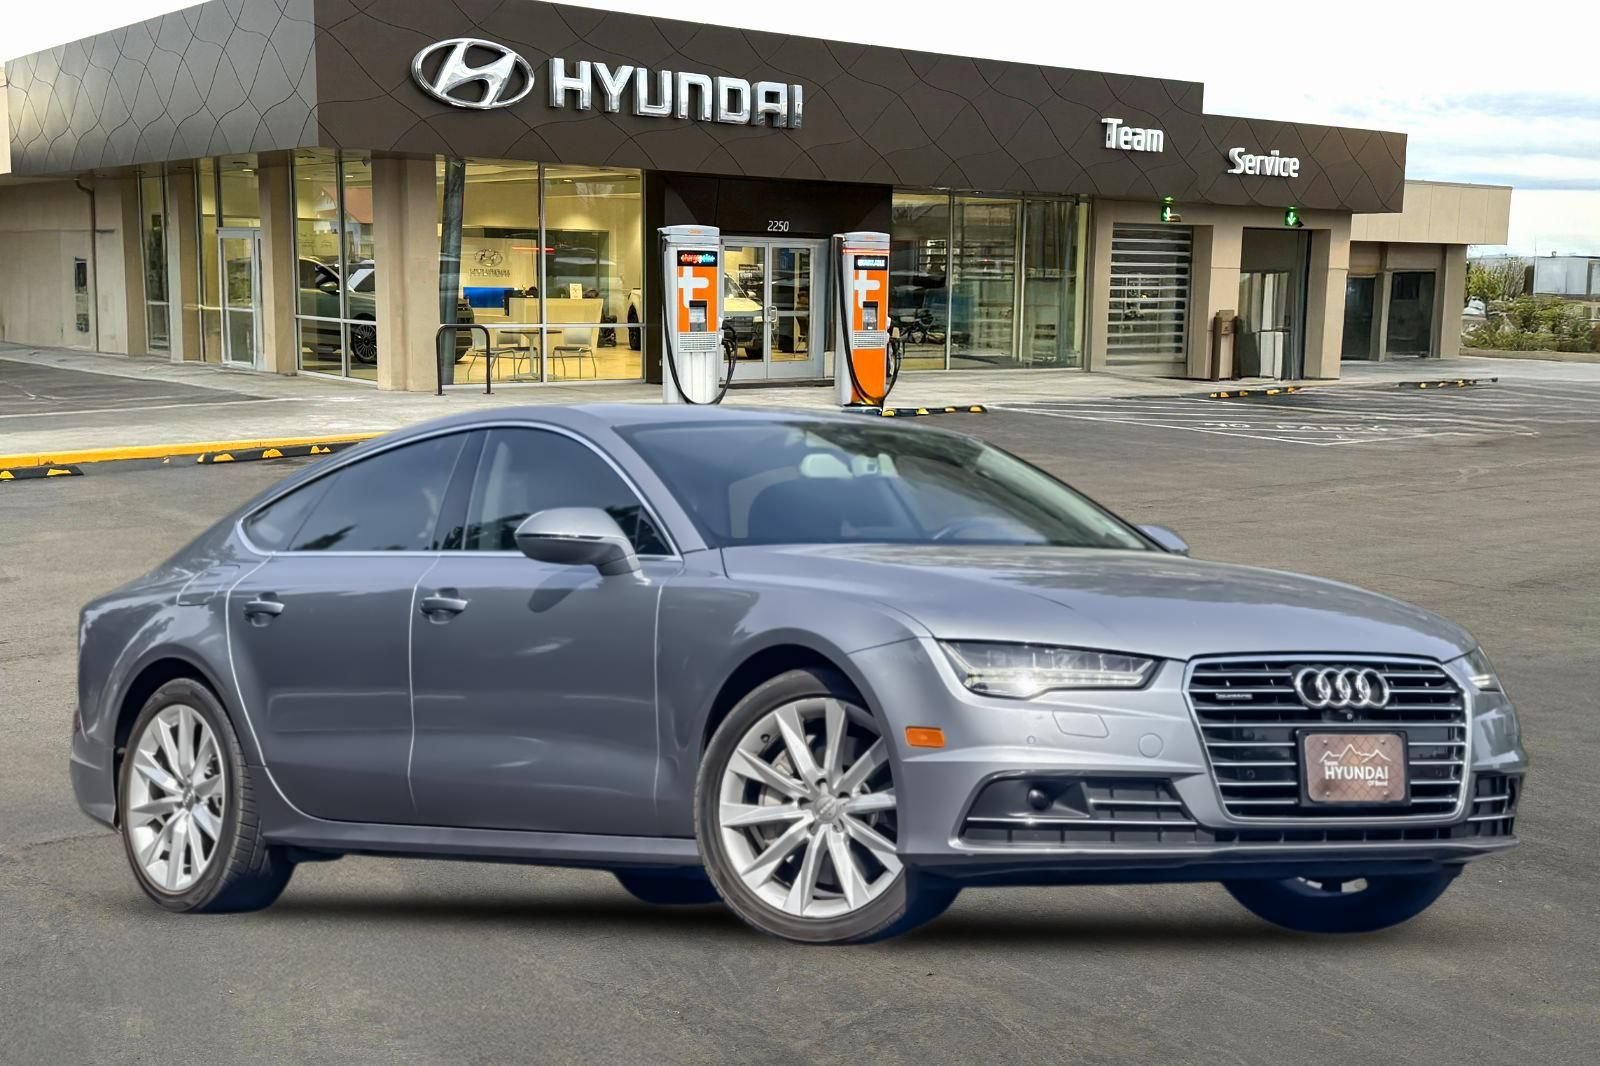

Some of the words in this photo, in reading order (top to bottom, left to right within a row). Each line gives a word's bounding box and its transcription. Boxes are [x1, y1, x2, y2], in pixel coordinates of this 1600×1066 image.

[550, 58, 803, 128] HYUNDAI
[1102, 118, 1164, 152] Team
[1228, 147, 1299, 177] Service
[767, 220, 790, 232] 2250
[1325, 766, 1388, 779] HYUNDAI
